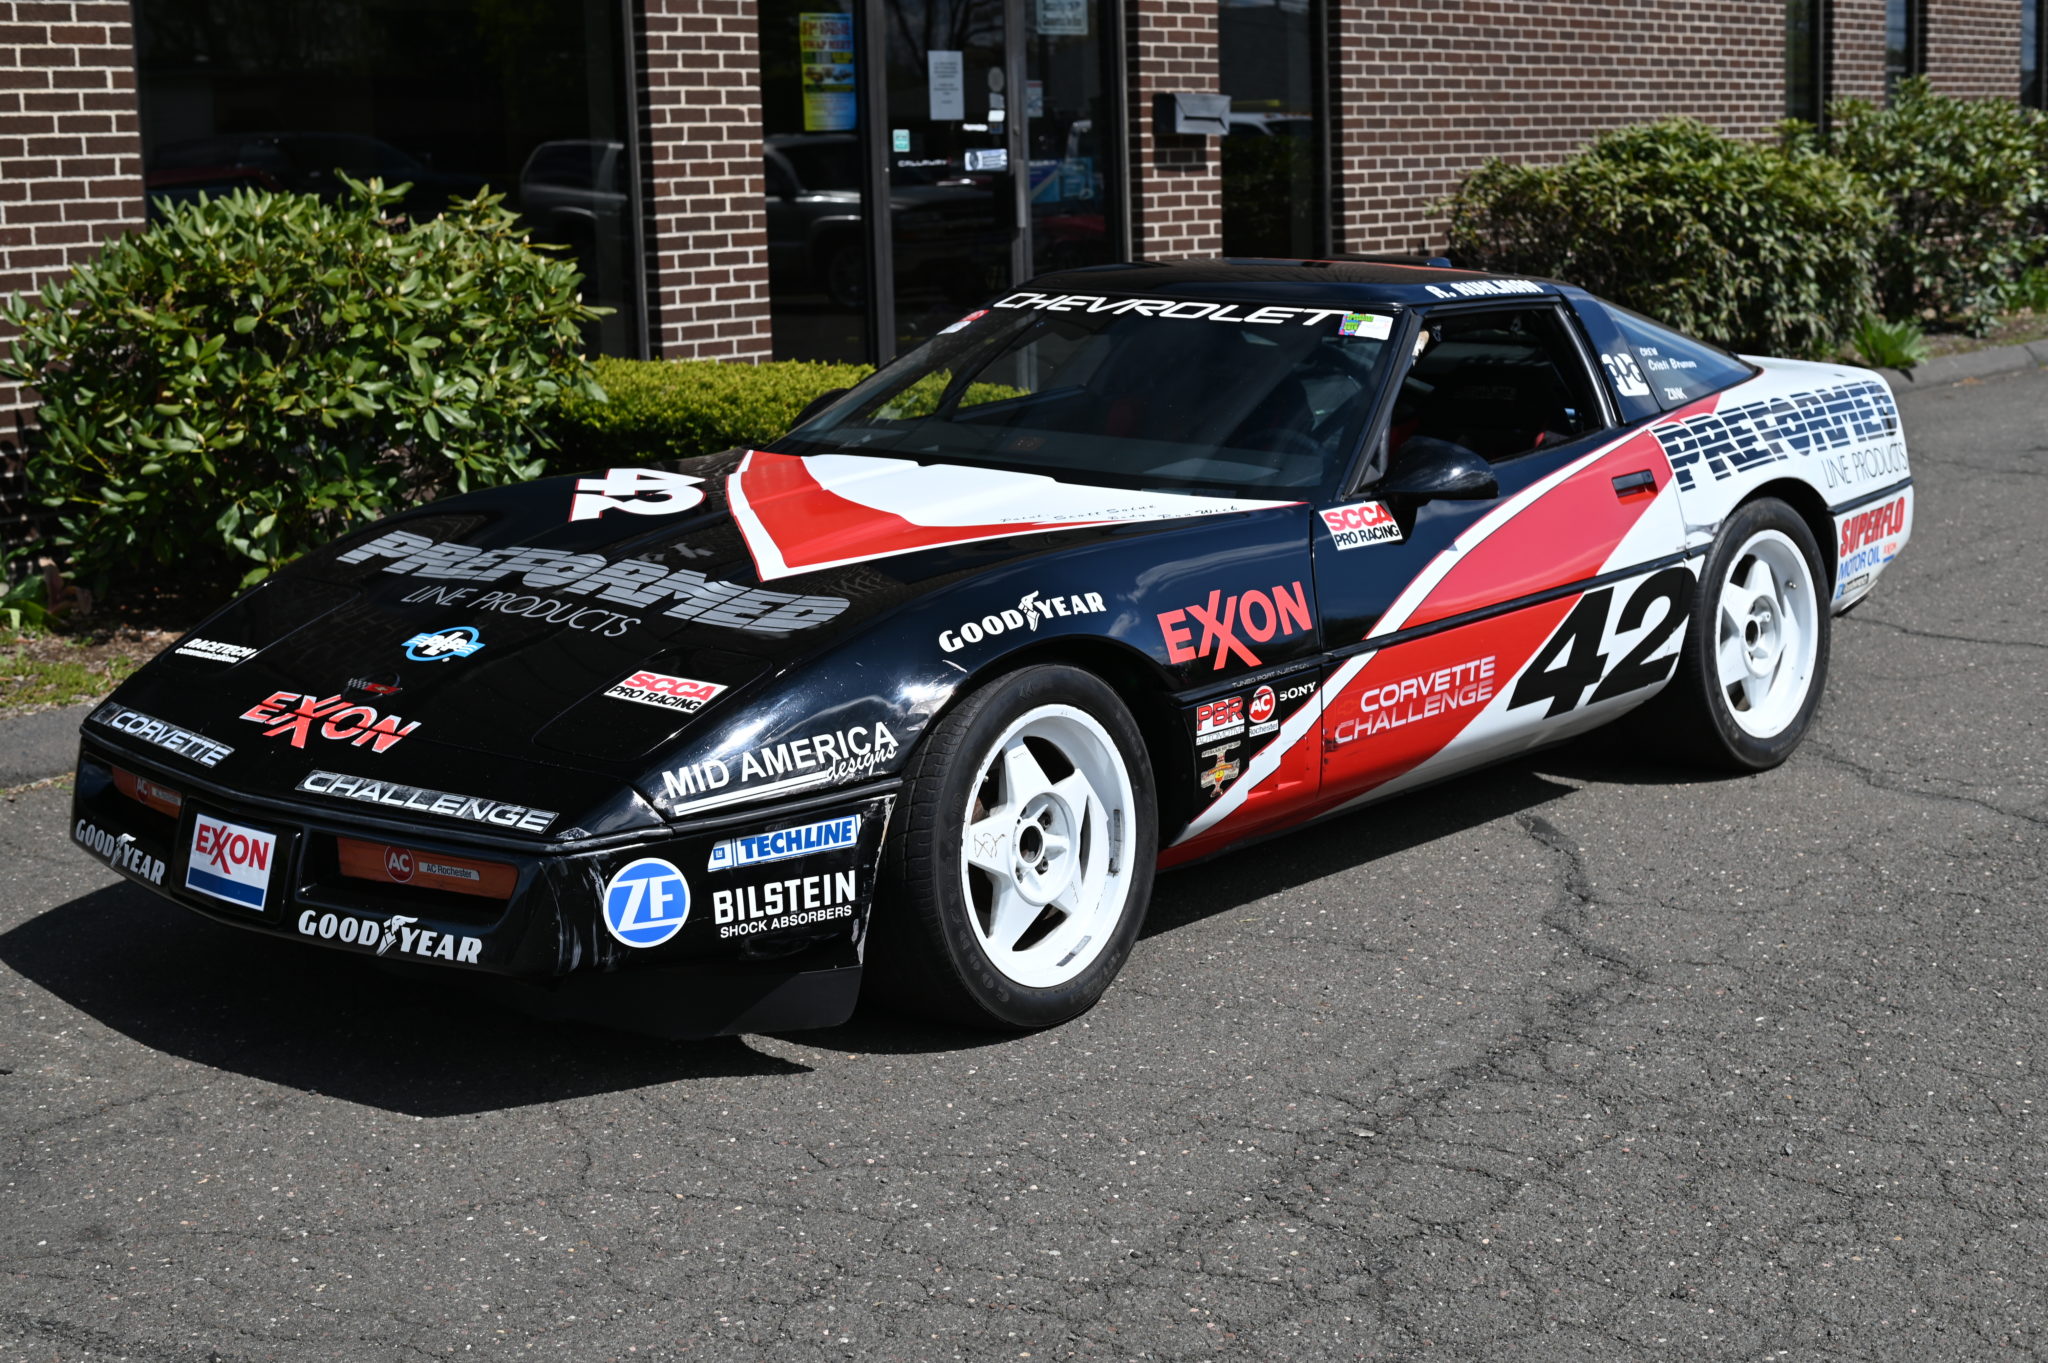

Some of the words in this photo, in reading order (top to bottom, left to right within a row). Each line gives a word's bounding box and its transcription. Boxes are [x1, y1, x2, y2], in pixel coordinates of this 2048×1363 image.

[993, 292, 1353, 327] CHEVROLET
[1651, 380, 1898, 492] PREFORMED
[1821, 452, 1851, 489] LINE
[1852, 442, 1909, 484] PRODUCTS
[1323, 504, 1394, 533] SCCA
[1334, 529, 1359, 548] PRO
[1360, 524, 1400, 542] RACING
[1840, 496, 1905, 557] SUPERFLO
[336, 530, 850, 633] PREFORMED
[1838, 551, 1867, 581] MOTOR
[1868, 545, 1881, 567] OIL
[401, 585, 479, 606] LINE
[466, 591, 642, 637] PRODUCTS
[938, 591, 1107, 653] GOODYEAR
[1156, 580, 1313, 671] EXXON
[1506, 566, 1698, 720] 42
[608, 686, 645, 699] PRO
[641, 692, 702, 711] RACING
[624, 673, 717, 701] SCCA
[1232, 677, 1257, 688] TUNED
[1256, 671, 1276, 681] PORT
[1250, 694, 1271, 715] AC
[1279, 681, 1317, 702] SONY
[1360, 655, 1496, 713] CORVETTE
[239, 690, 422, 754] EXXON
[1197, 697, 1245, 732] PBR
[1334, 678, 1494, 744] CHALLENGE
[111, 711, 232, 767] CORVETTE
[661, 759, 730, 799] MID
[740, 721, 899, 782] AMERICA
[825, 743, 898, 782] designs
[302, 771, 559, 833] CHALLENGE
[75, 819, 166, 886] GOODYEAR
[195, 823, 270, 875] EXXON
[388, 852, 410, 872] AC
[740, 820, 853, 860] TECHLINE
[426, 863, 437, 873] AC
[437, 865, 472, 879] Rochester
[610, 873, 683, 933] ZF
[712, 870, 856, 925] BILSTEIN
[720, 919, 768, 939] SHOCK
[770, 905, 853, 930] ABSORBERS
[298, 909, 483, 965] GOODYEAR
